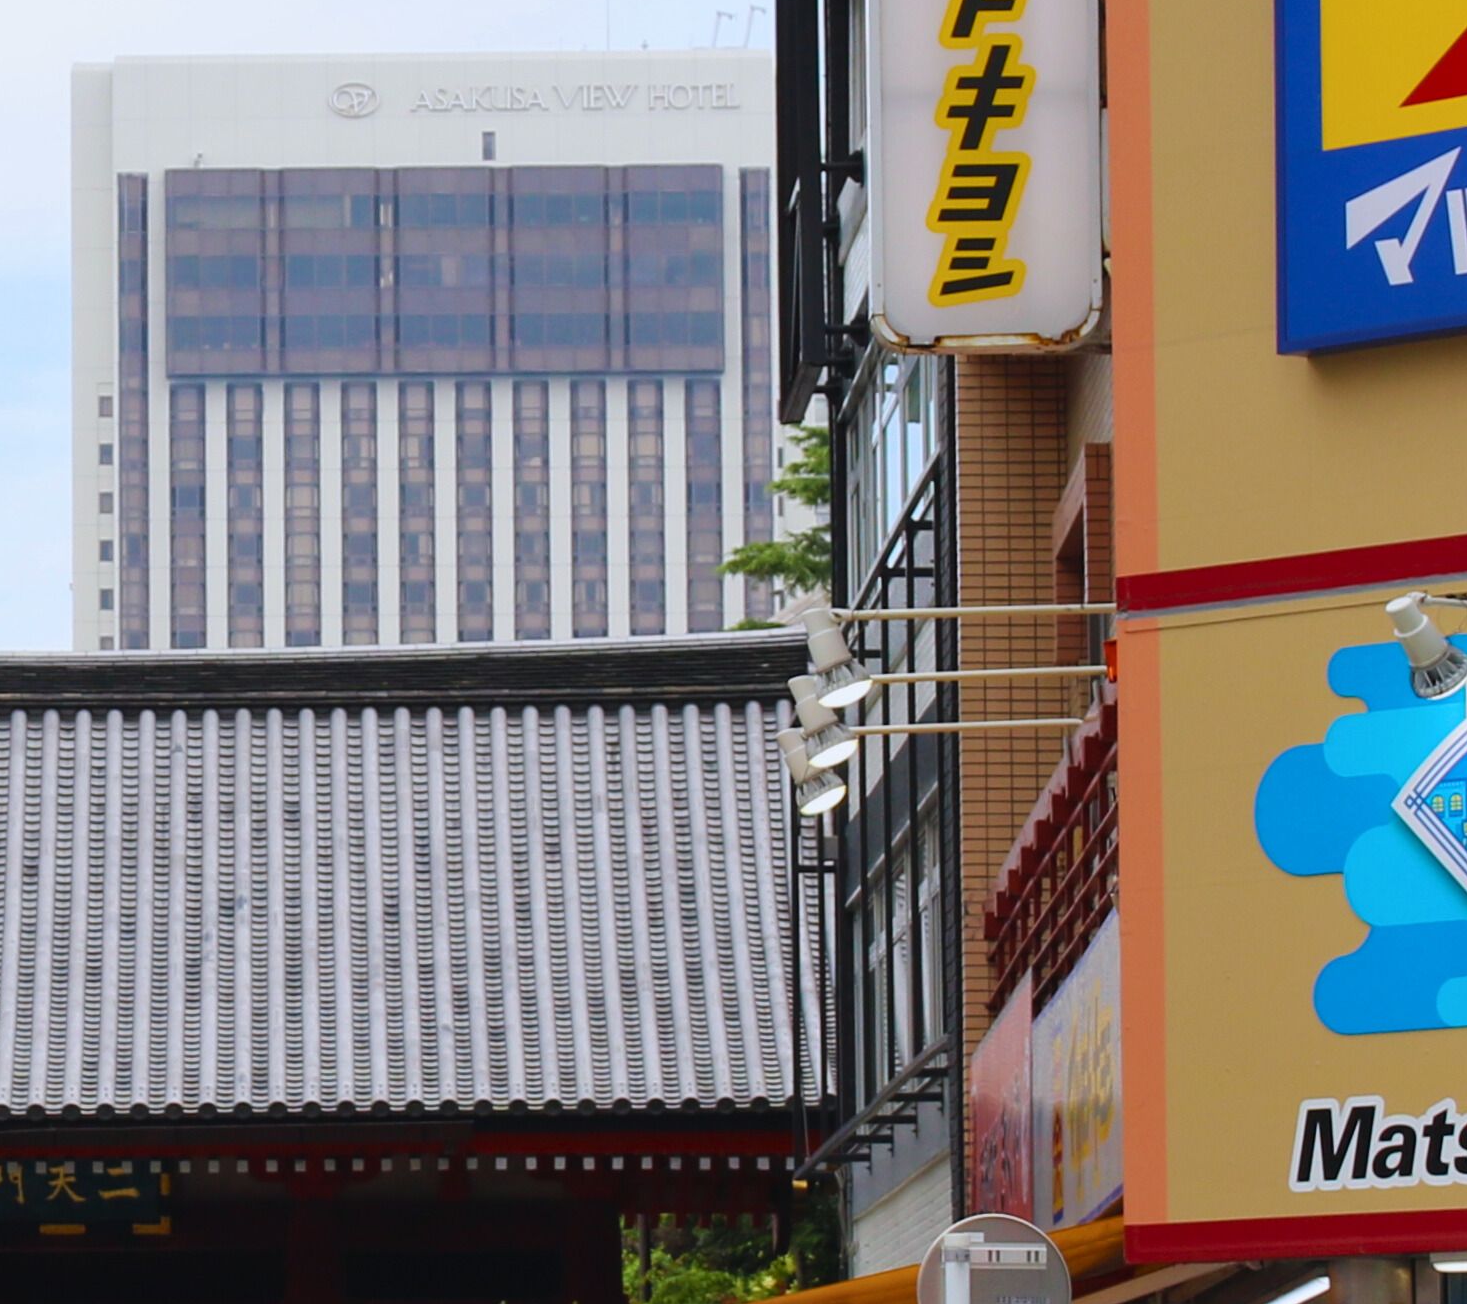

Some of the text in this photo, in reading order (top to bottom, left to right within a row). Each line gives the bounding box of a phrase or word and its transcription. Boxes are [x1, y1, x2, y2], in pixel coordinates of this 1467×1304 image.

[410, 81, 742, 112] ASAKUSA VIEW HOTEL
